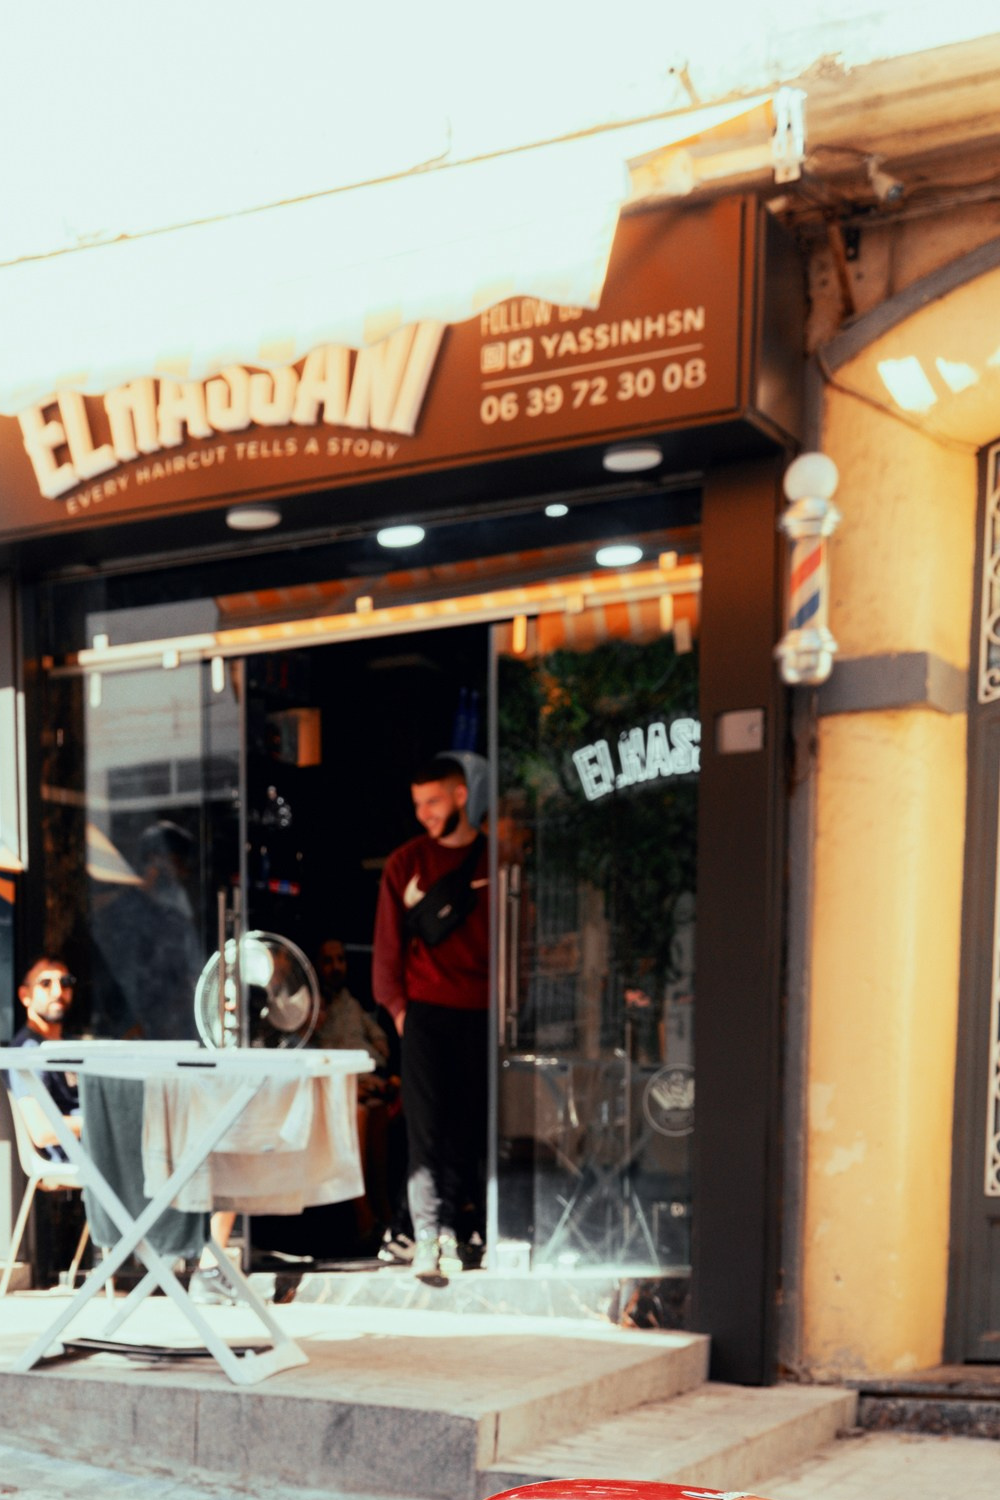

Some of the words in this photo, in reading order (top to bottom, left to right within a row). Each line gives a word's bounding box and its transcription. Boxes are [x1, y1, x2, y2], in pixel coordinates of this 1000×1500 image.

[540, 306, 705, 359] YASSINHSN
[480, 392, 519, 425] 06
[526, 384, 563, 418] 39
[571, 376, 608, 409] 72
[616, 368, 656, 401] 30
[662, 358, 707, 392] 08
[66, 475, 129, 515] EVERY
[136, 446, 228, 485] HAIRCUT
[234, 437, 298, 461] TELLS
[304, 437, 319, 456] A
[326, 437, 400, 461] STORY
